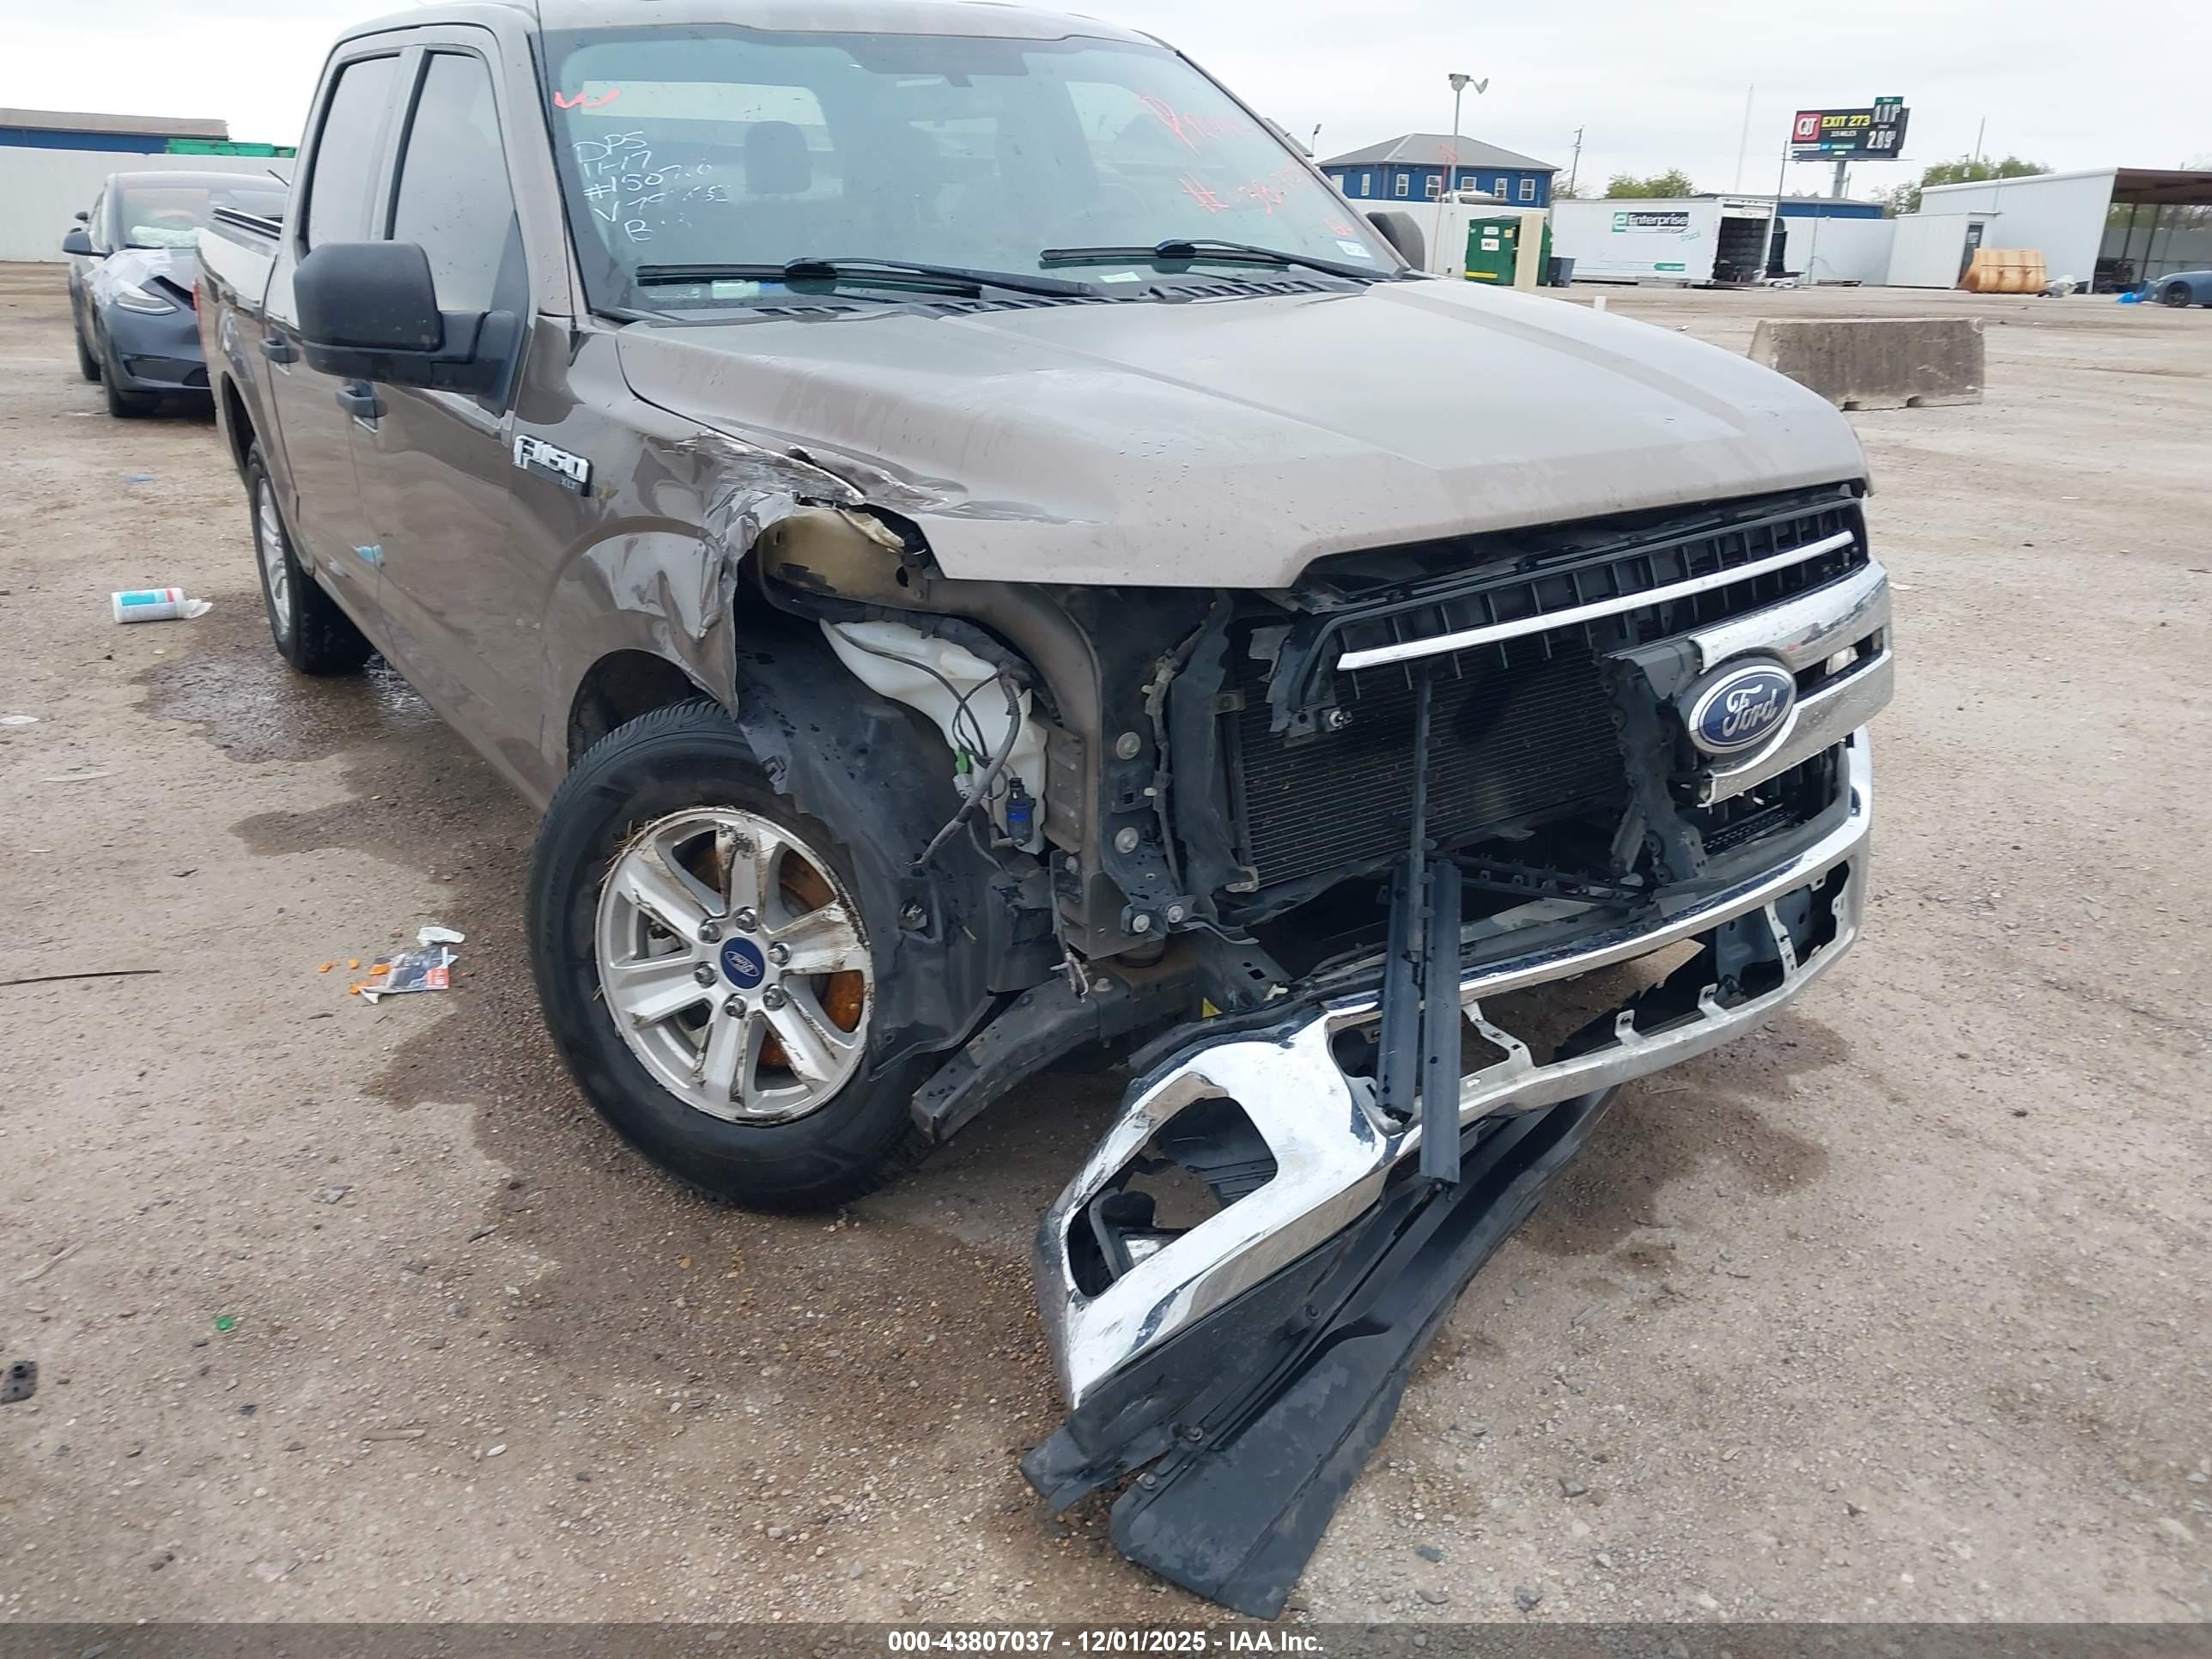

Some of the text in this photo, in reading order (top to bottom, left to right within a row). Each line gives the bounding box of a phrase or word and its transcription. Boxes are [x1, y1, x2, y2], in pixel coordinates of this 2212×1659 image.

[1821, 116, 1848, 128] EXIT
[1848, 114, 1871, 126] 273
[1628, 214, 1689, 227] Enterprise
[1722, 684, 1778, 738] Ford
